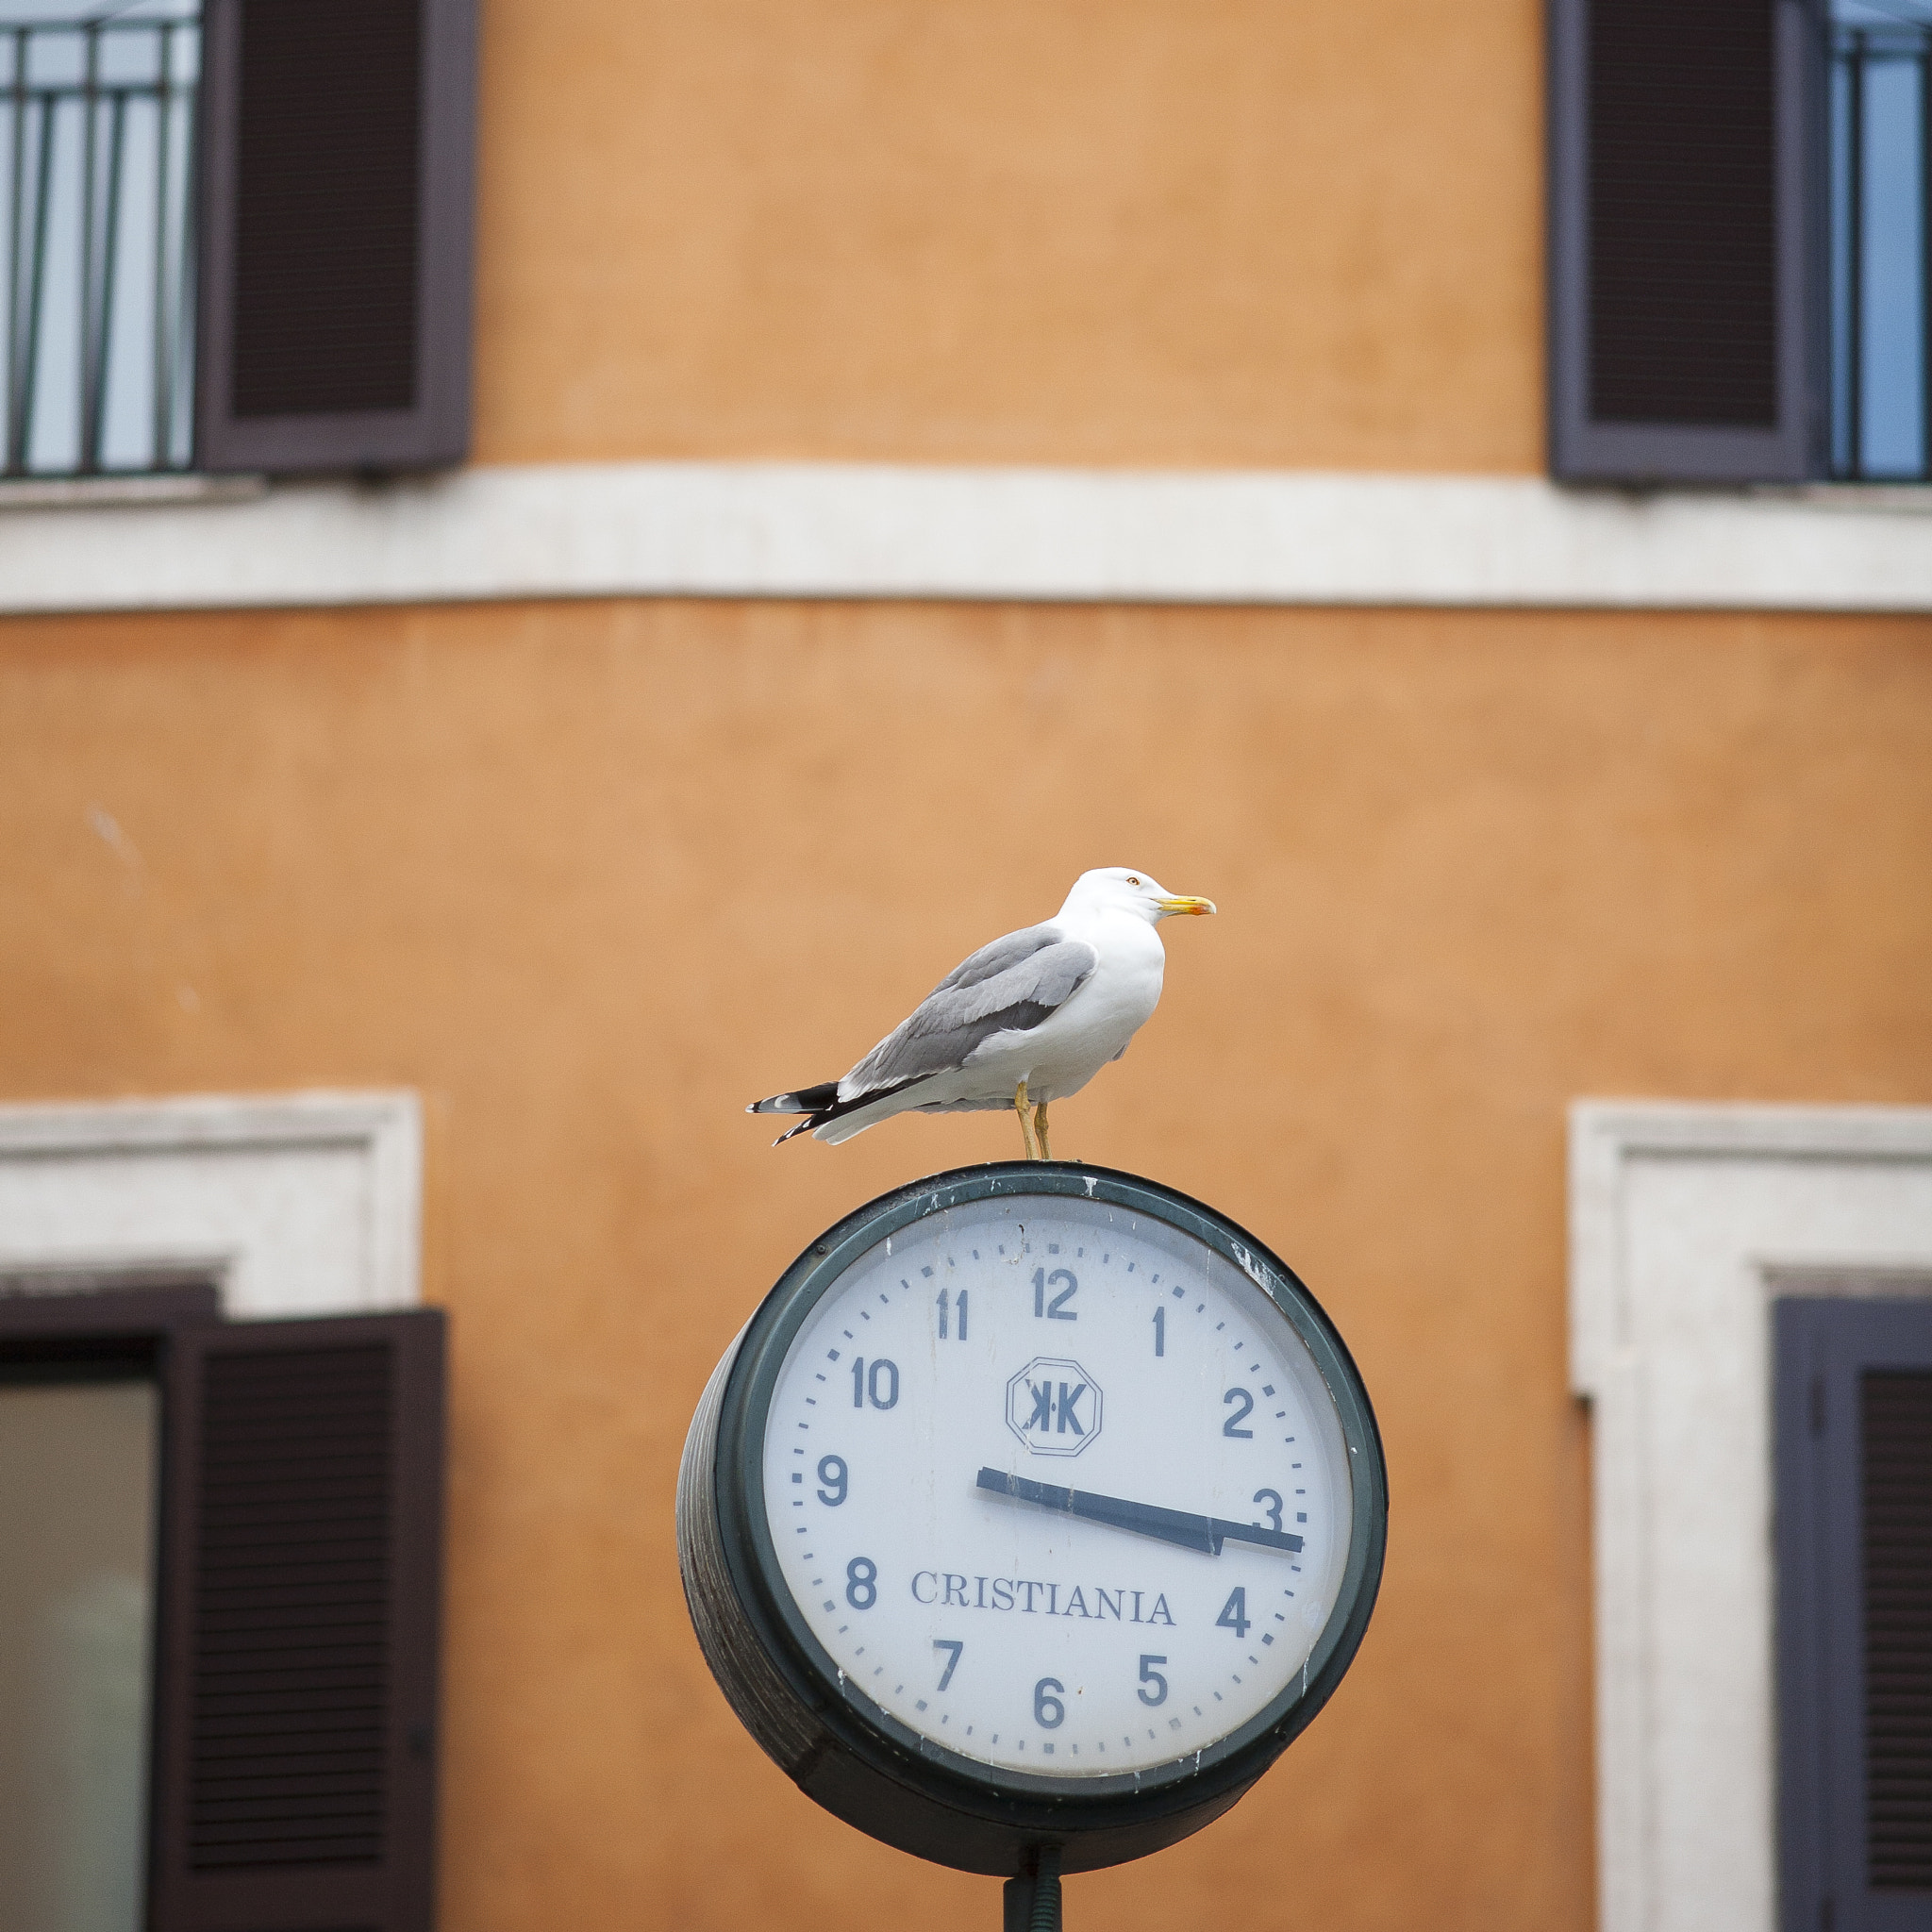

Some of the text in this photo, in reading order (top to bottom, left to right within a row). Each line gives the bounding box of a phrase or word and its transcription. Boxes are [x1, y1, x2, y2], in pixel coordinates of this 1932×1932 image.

[936, 1289, 968, 1341] 11
[1031, 1267, 1078, 1321] 12
[1152, 1306, 1165, 1357] 1
[851, 1357, 899, 1409] 10
[1223, 1387, 1254, 1439] 2
[817, 1455, 848, 1507] 9
[1253, 1488, 1283, 1532] 3
[846, 1557, 877, 1610] 8
[911, 1571, 1177, 1625] CRISTIANIA
[1215, 1587, 1251, 1638] 4
[933, 1640, 963, 1691] 7
[1137, 1654, 1168, 1707] 5
[1034, 1677, 1065, 1729] 6
